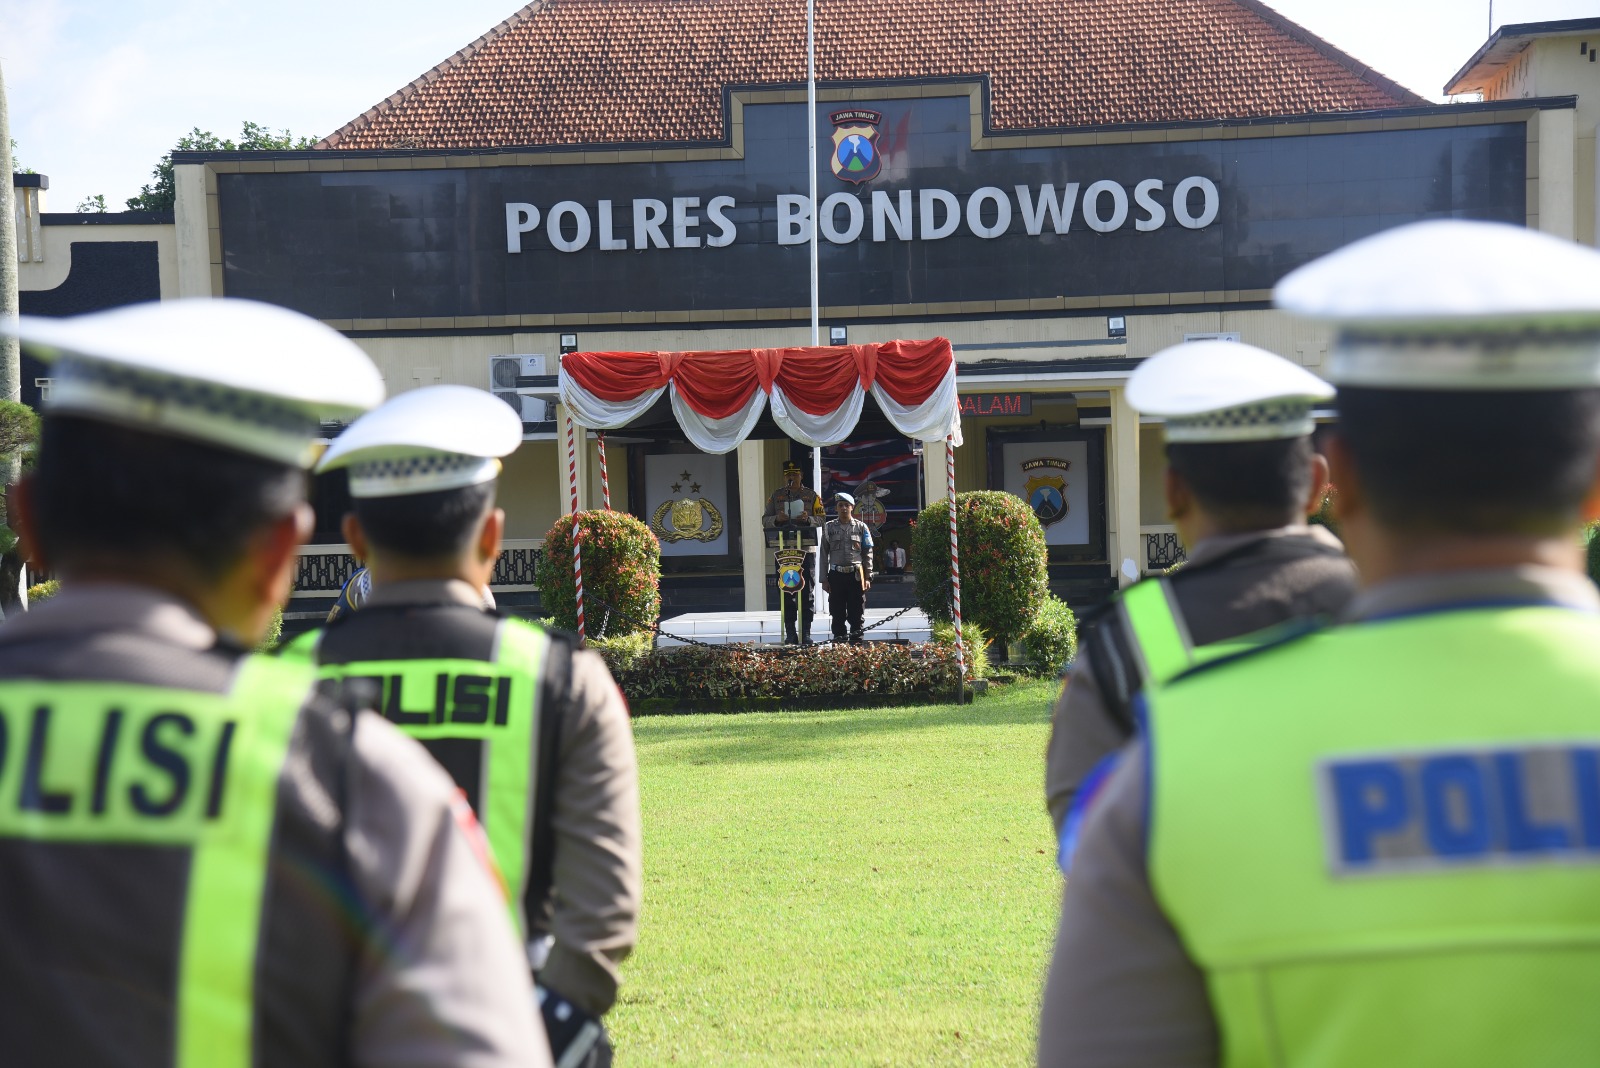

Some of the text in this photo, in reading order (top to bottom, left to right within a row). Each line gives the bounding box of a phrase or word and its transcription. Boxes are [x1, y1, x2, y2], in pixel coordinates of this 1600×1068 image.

[836, 112, 875, 120] JAWA TIMUR
[505, 175, 1220, 254] POLRES BONDOWOSO
[1024, 460, 1067, 470] JAWA TIMUR
[0, 703, 237, 821] LISI
